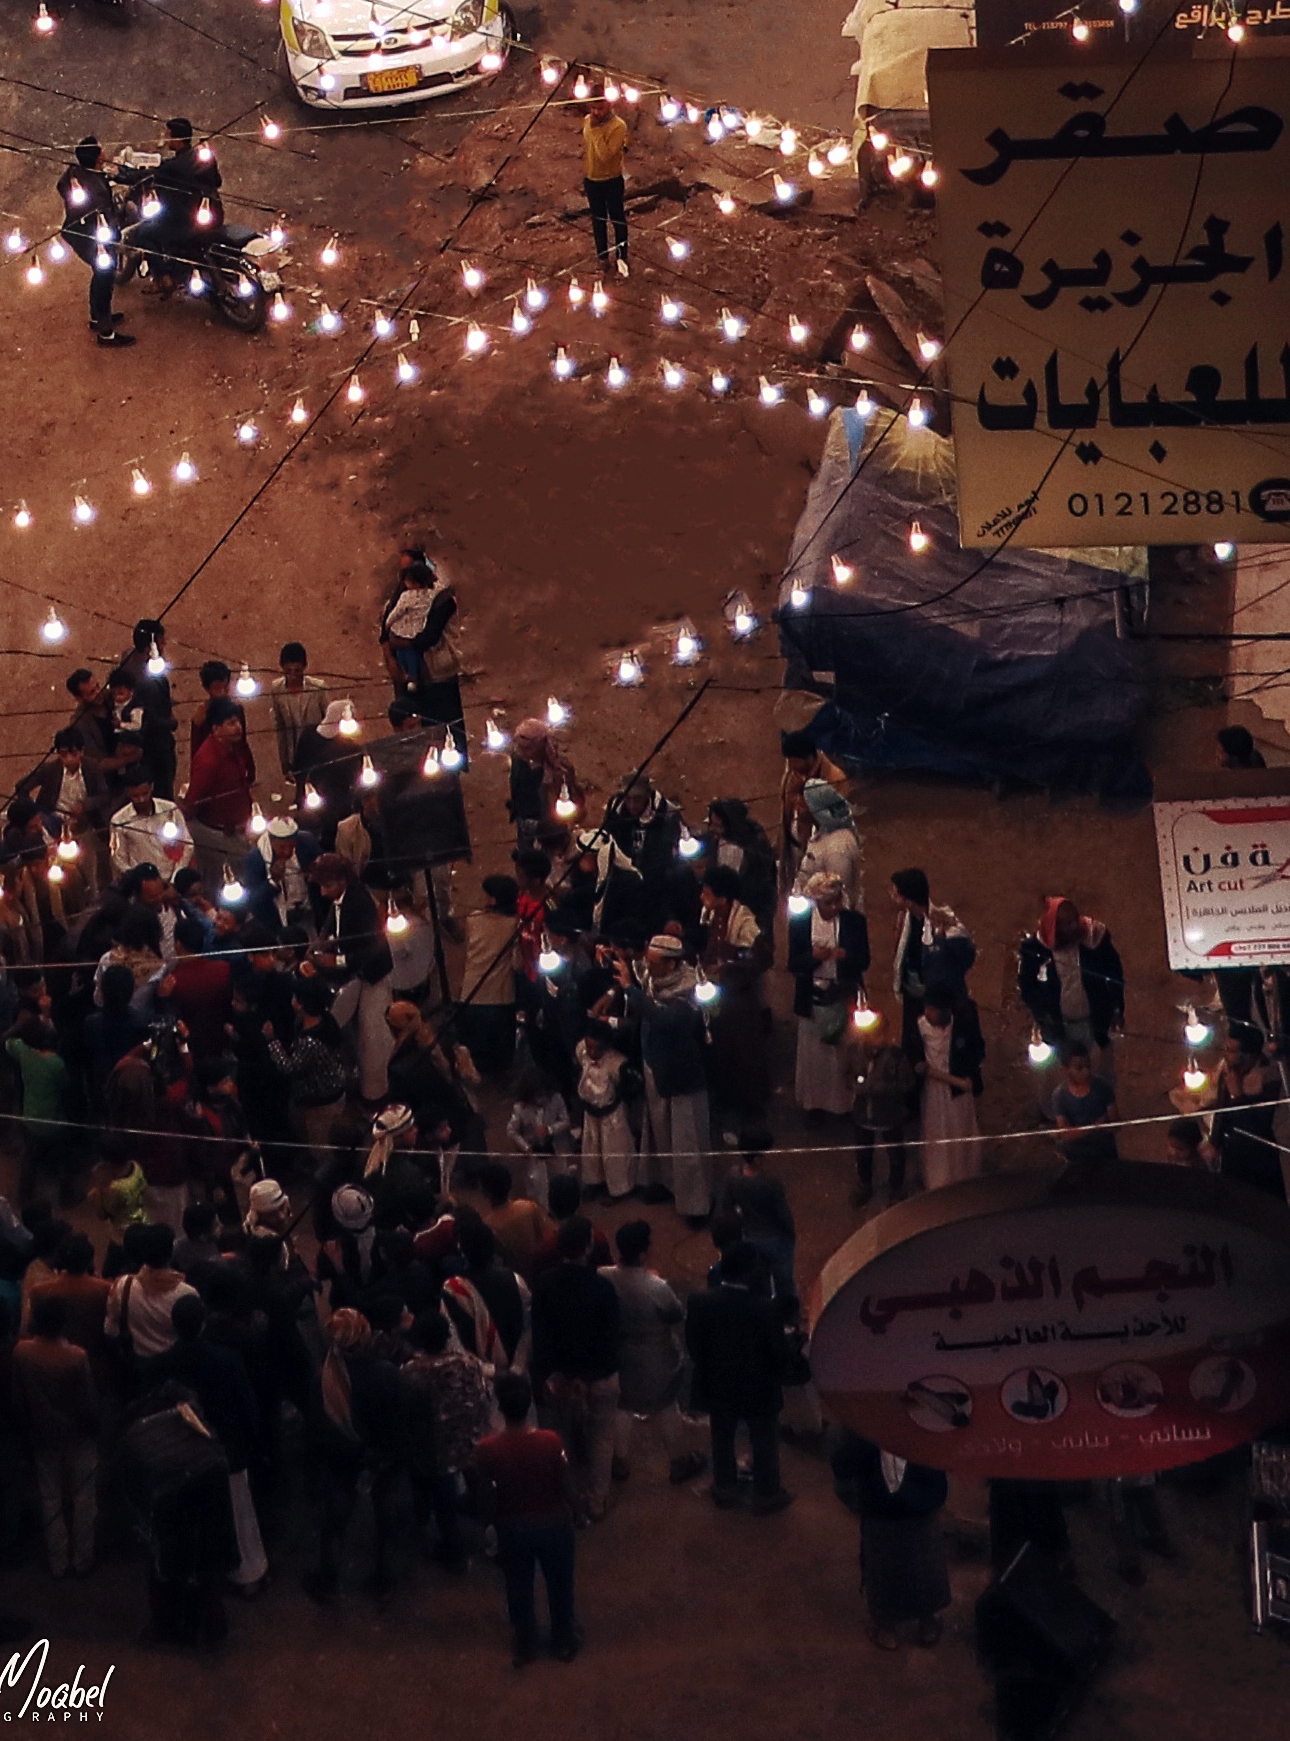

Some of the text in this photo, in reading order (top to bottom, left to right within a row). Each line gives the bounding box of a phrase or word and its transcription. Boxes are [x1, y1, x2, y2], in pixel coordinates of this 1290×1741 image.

[959, 80, 1285, 186] صقر
[976, 214, 1284, 311] الجزيرة
[976, 340, 1290, 465] للعبايات
[1067, 491, 1243, 518] 01212881
[1186, 877, 1245, 893] Art cut
[859, 1242, 1234, 1336] النجم الذهبي
[934, 1314, 1188, 1352] للأحذية العالمية
